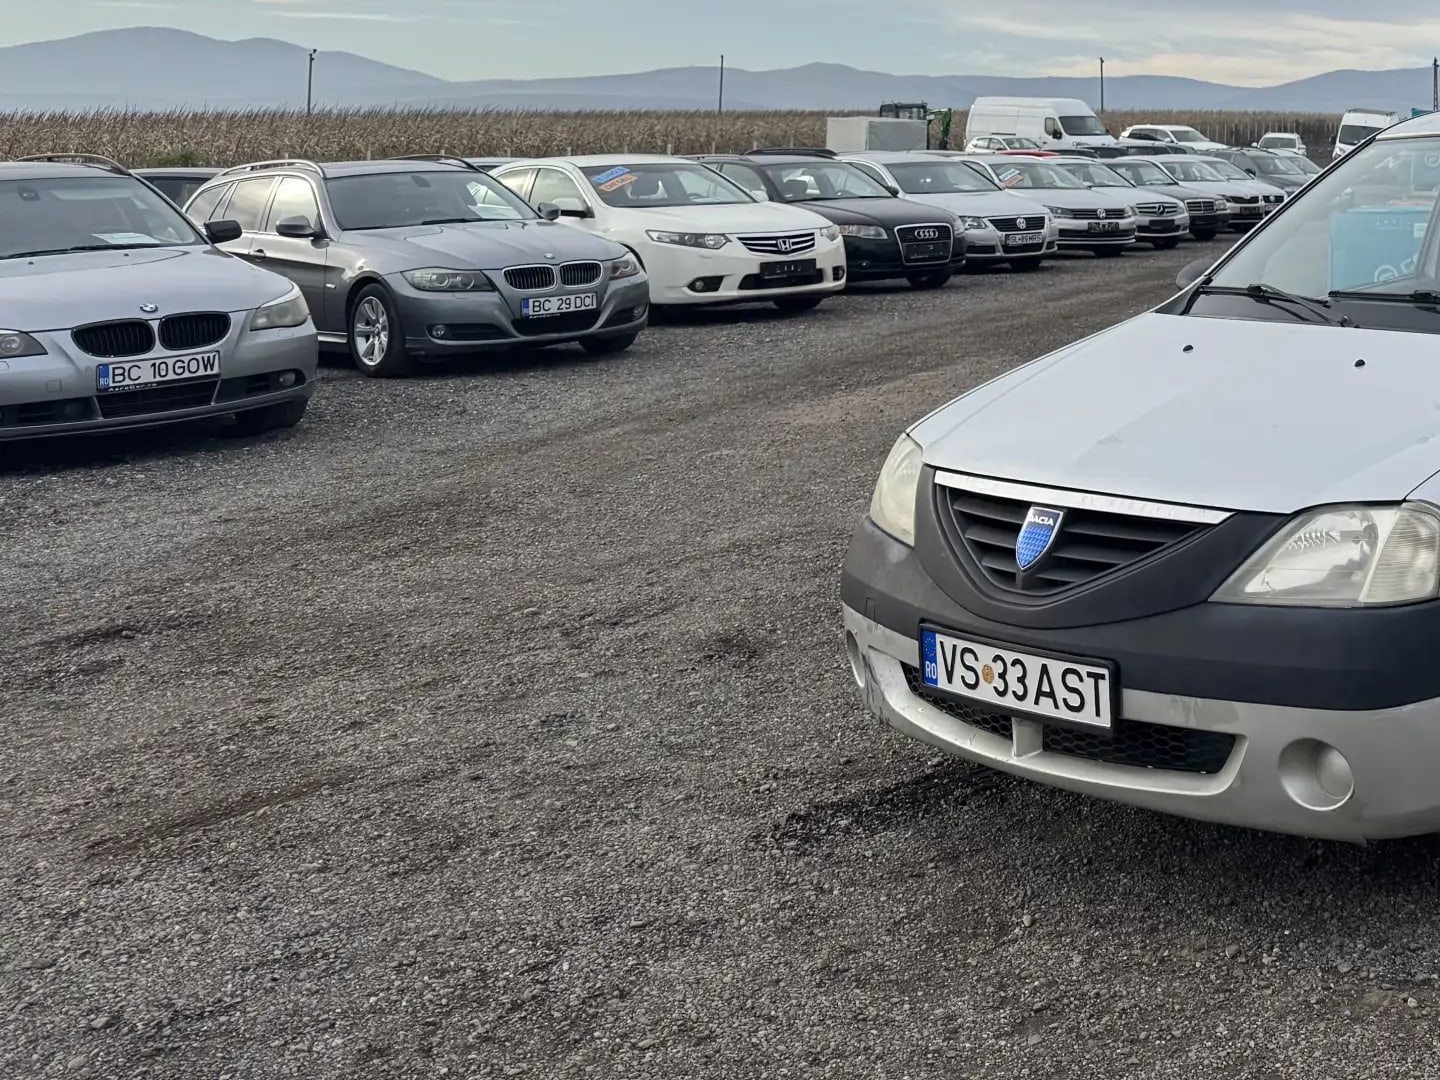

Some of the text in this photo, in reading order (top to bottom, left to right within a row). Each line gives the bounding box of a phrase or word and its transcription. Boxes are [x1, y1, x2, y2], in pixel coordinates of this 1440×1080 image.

[532, 299, 552, 313] BC
[557, 297, 571, 311] 29
[574, 294, 595, 309] DCI
[111, 354, 217, 384] BC 10 GOW
[925, 661, 937, 680] RO
[939, 640, 1107, 718] VS 33 AST
